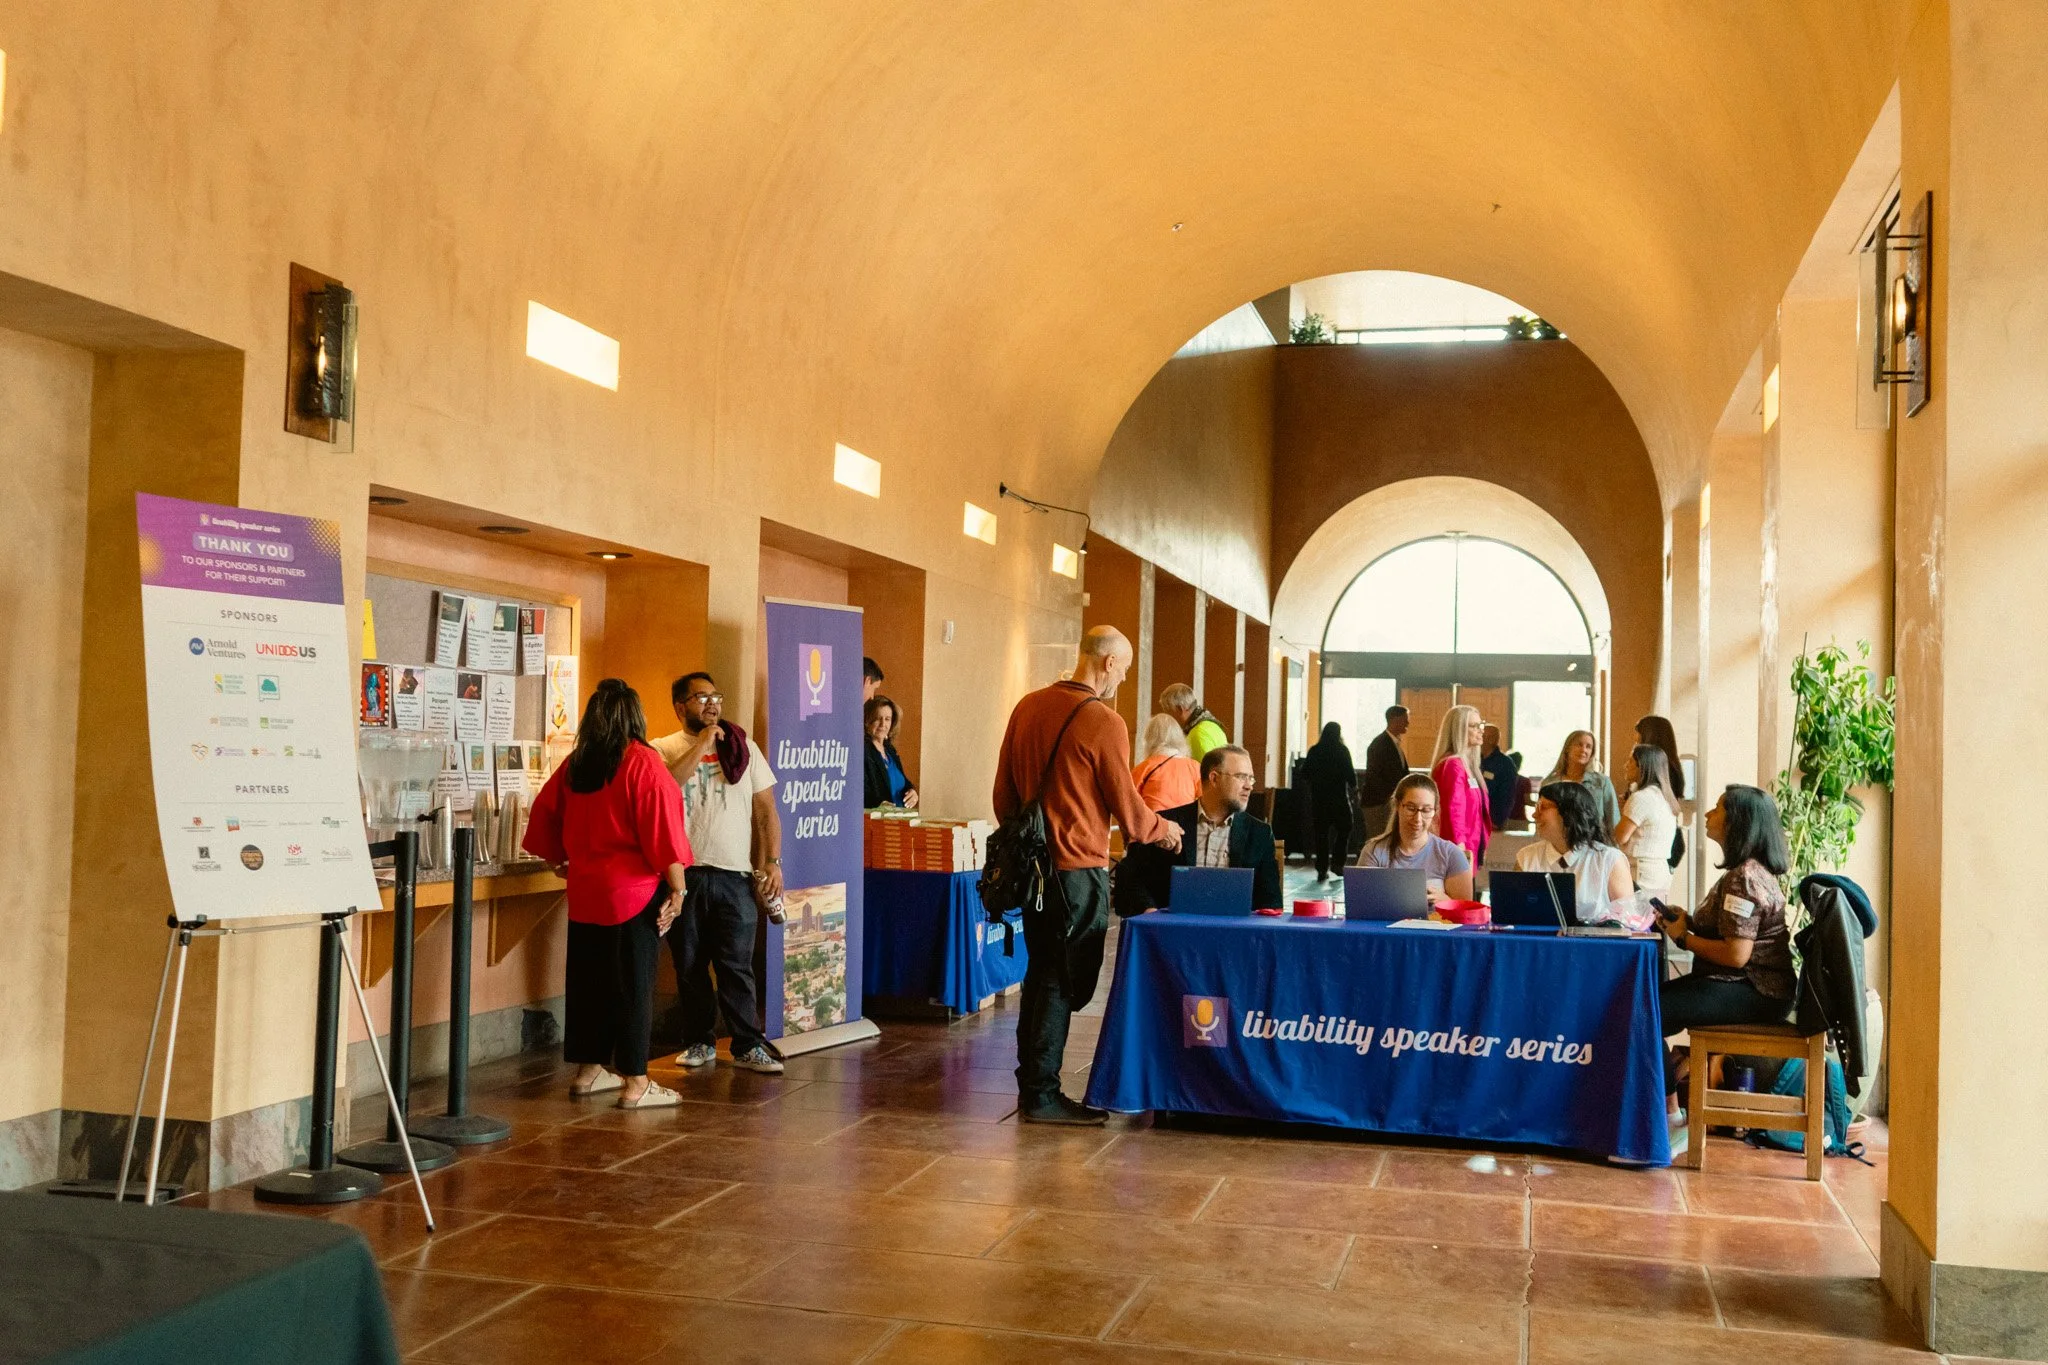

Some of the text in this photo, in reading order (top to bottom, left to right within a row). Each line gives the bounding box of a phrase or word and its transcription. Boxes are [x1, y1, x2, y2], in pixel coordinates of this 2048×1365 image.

[198, 535, 289, 558] THANK YOU
[182, 555, 306, 577] TO OUR SPONSORS & PARTNERS
[205, 570, 286, 587] FOR THEIR SUPPORT!
[220, 609, 278, 623] SPONSORS
[206, 638, 237, 649] Arnold
[206, 648, 246, 659] Ventures
[777, 739, 849, 777] livability
[235, 785, 290, 794] PARTNERS
[782, 773, 846, 813] speaker
[795, 807, 839, 840] series
[1242, 1010, 1593, 1066] livability speaker series
